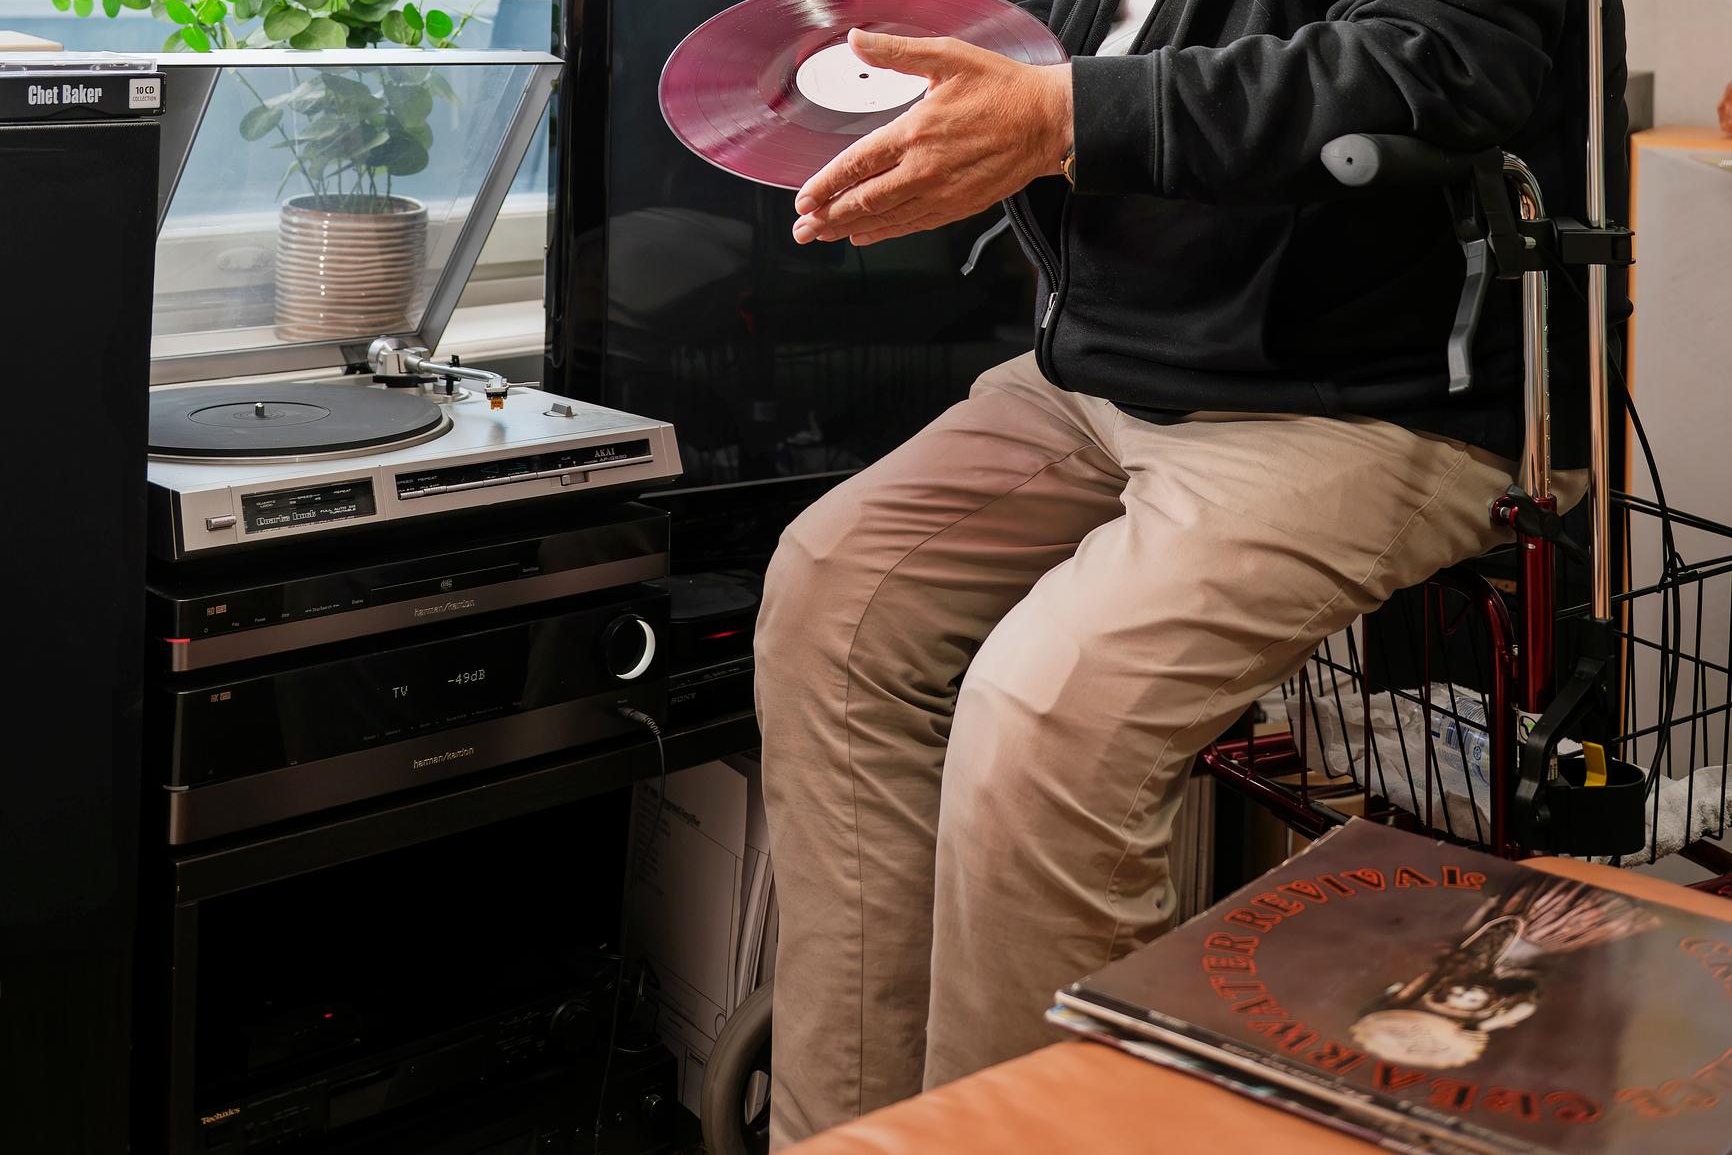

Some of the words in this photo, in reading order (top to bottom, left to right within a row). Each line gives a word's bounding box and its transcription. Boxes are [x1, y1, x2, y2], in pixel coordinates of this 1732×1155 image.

[27, 84, 59, 106] Chet
[62, 83, 103, 105] Baker
[135, 86, 144, 95] 10
[144, 85, 155, 95] CD
[594, 447, 615, 458] AKAI
[392, 685, 408, 699] TV
[447, 668, 486, 685] -49dB
[413, 747, 475, 770] harman/kardon
[1223, 864, 1488, 934] REVIVAL
[200, 1107, 241, 1126] Technics
